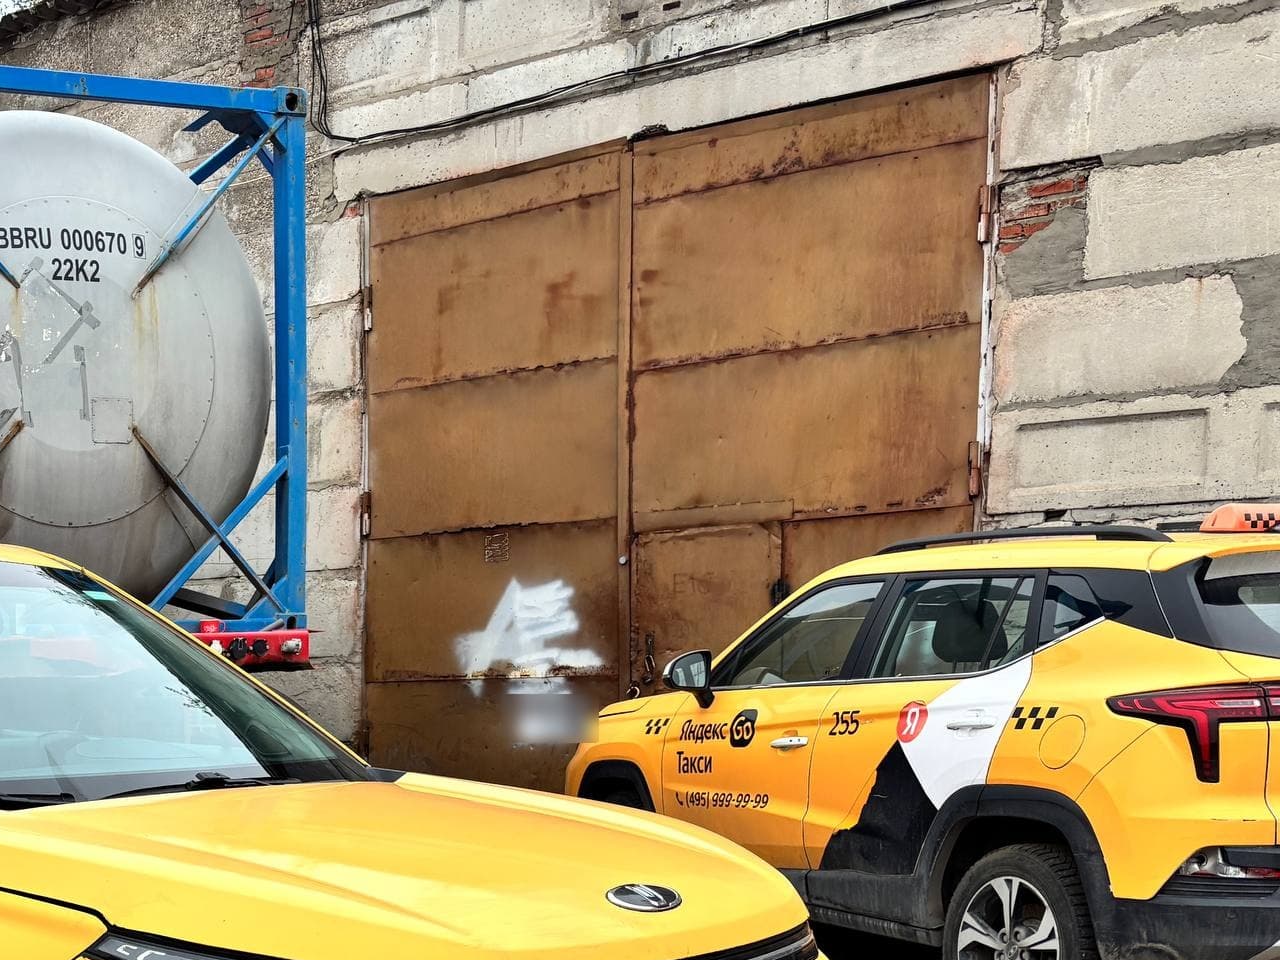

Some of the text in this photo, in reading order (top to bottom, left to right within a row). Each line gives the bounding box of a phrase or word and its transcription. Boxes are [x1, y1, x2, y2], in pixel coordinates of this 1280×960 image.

[60, 228, 127, 254] 000670
[134, 236, 144, 257] 9
[51, 258, 100, 282] 22K2
[680, 716, 753, 744] Яндекс Go
[829, 710, 860, 735] 255
[676, 751, 712, 774] Такси
[685, 791, 769, 809] (495) 999-99-99
